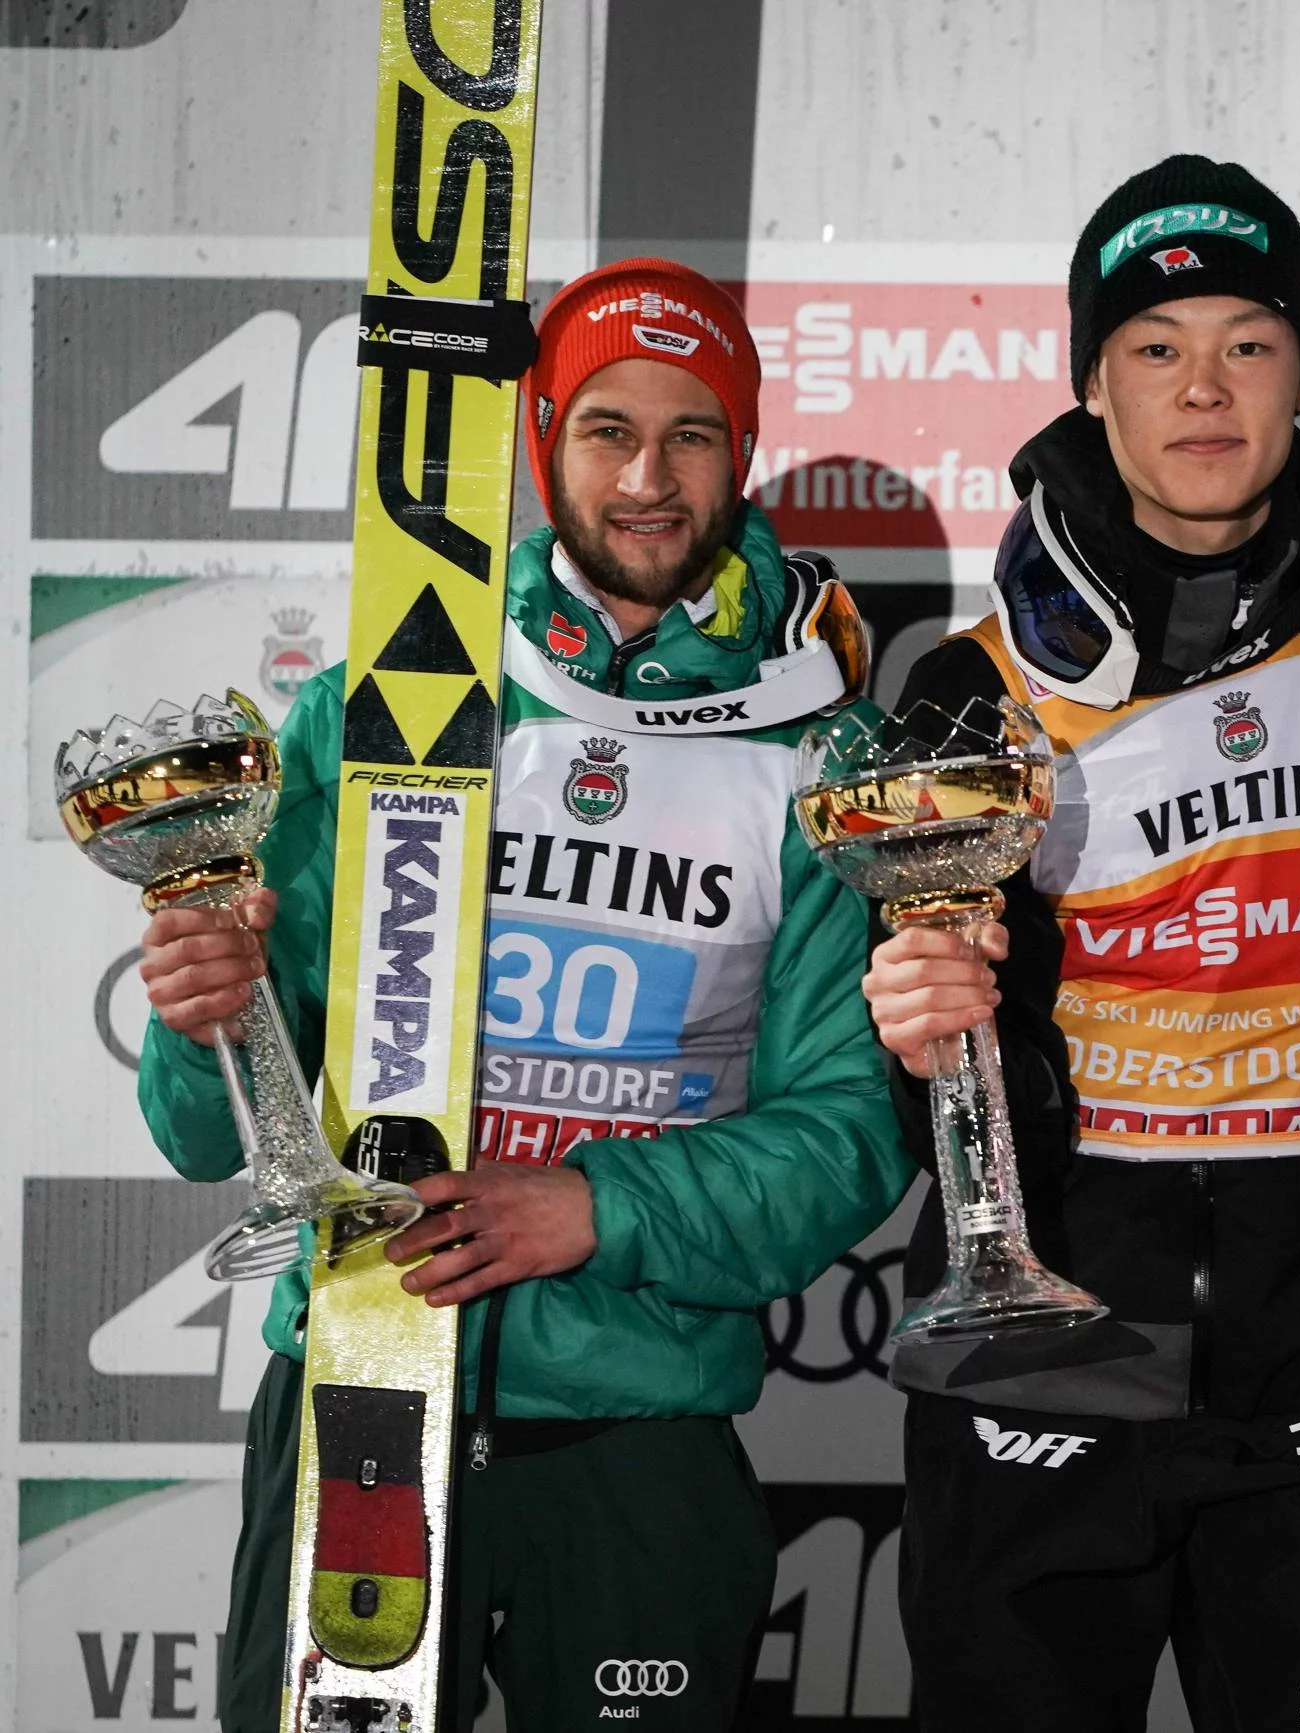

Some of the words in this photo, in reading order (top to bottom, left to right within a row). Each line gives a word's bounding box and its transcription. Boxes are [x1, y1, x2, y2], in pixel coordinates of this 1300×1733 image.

[1115, 207, 1257, 262] バスクリン
[588, 292, 734, 356] VIESSMANN
[635, 701, 750, 726] uvex
[348, 771, 488, 791] FISCHER
[370, 793, 460, 816] KAMPA
[368, 819, 442, 1104] KAMPA
[484, 932, 639, 1048] 30
[1056, 990, 1090, 1015] FIS
[1093, 1000, 1137, 1024] SKI
[1145, 1007, 1273, 1033] JUMPING
[599, 1706, 640, 1718] Audi
